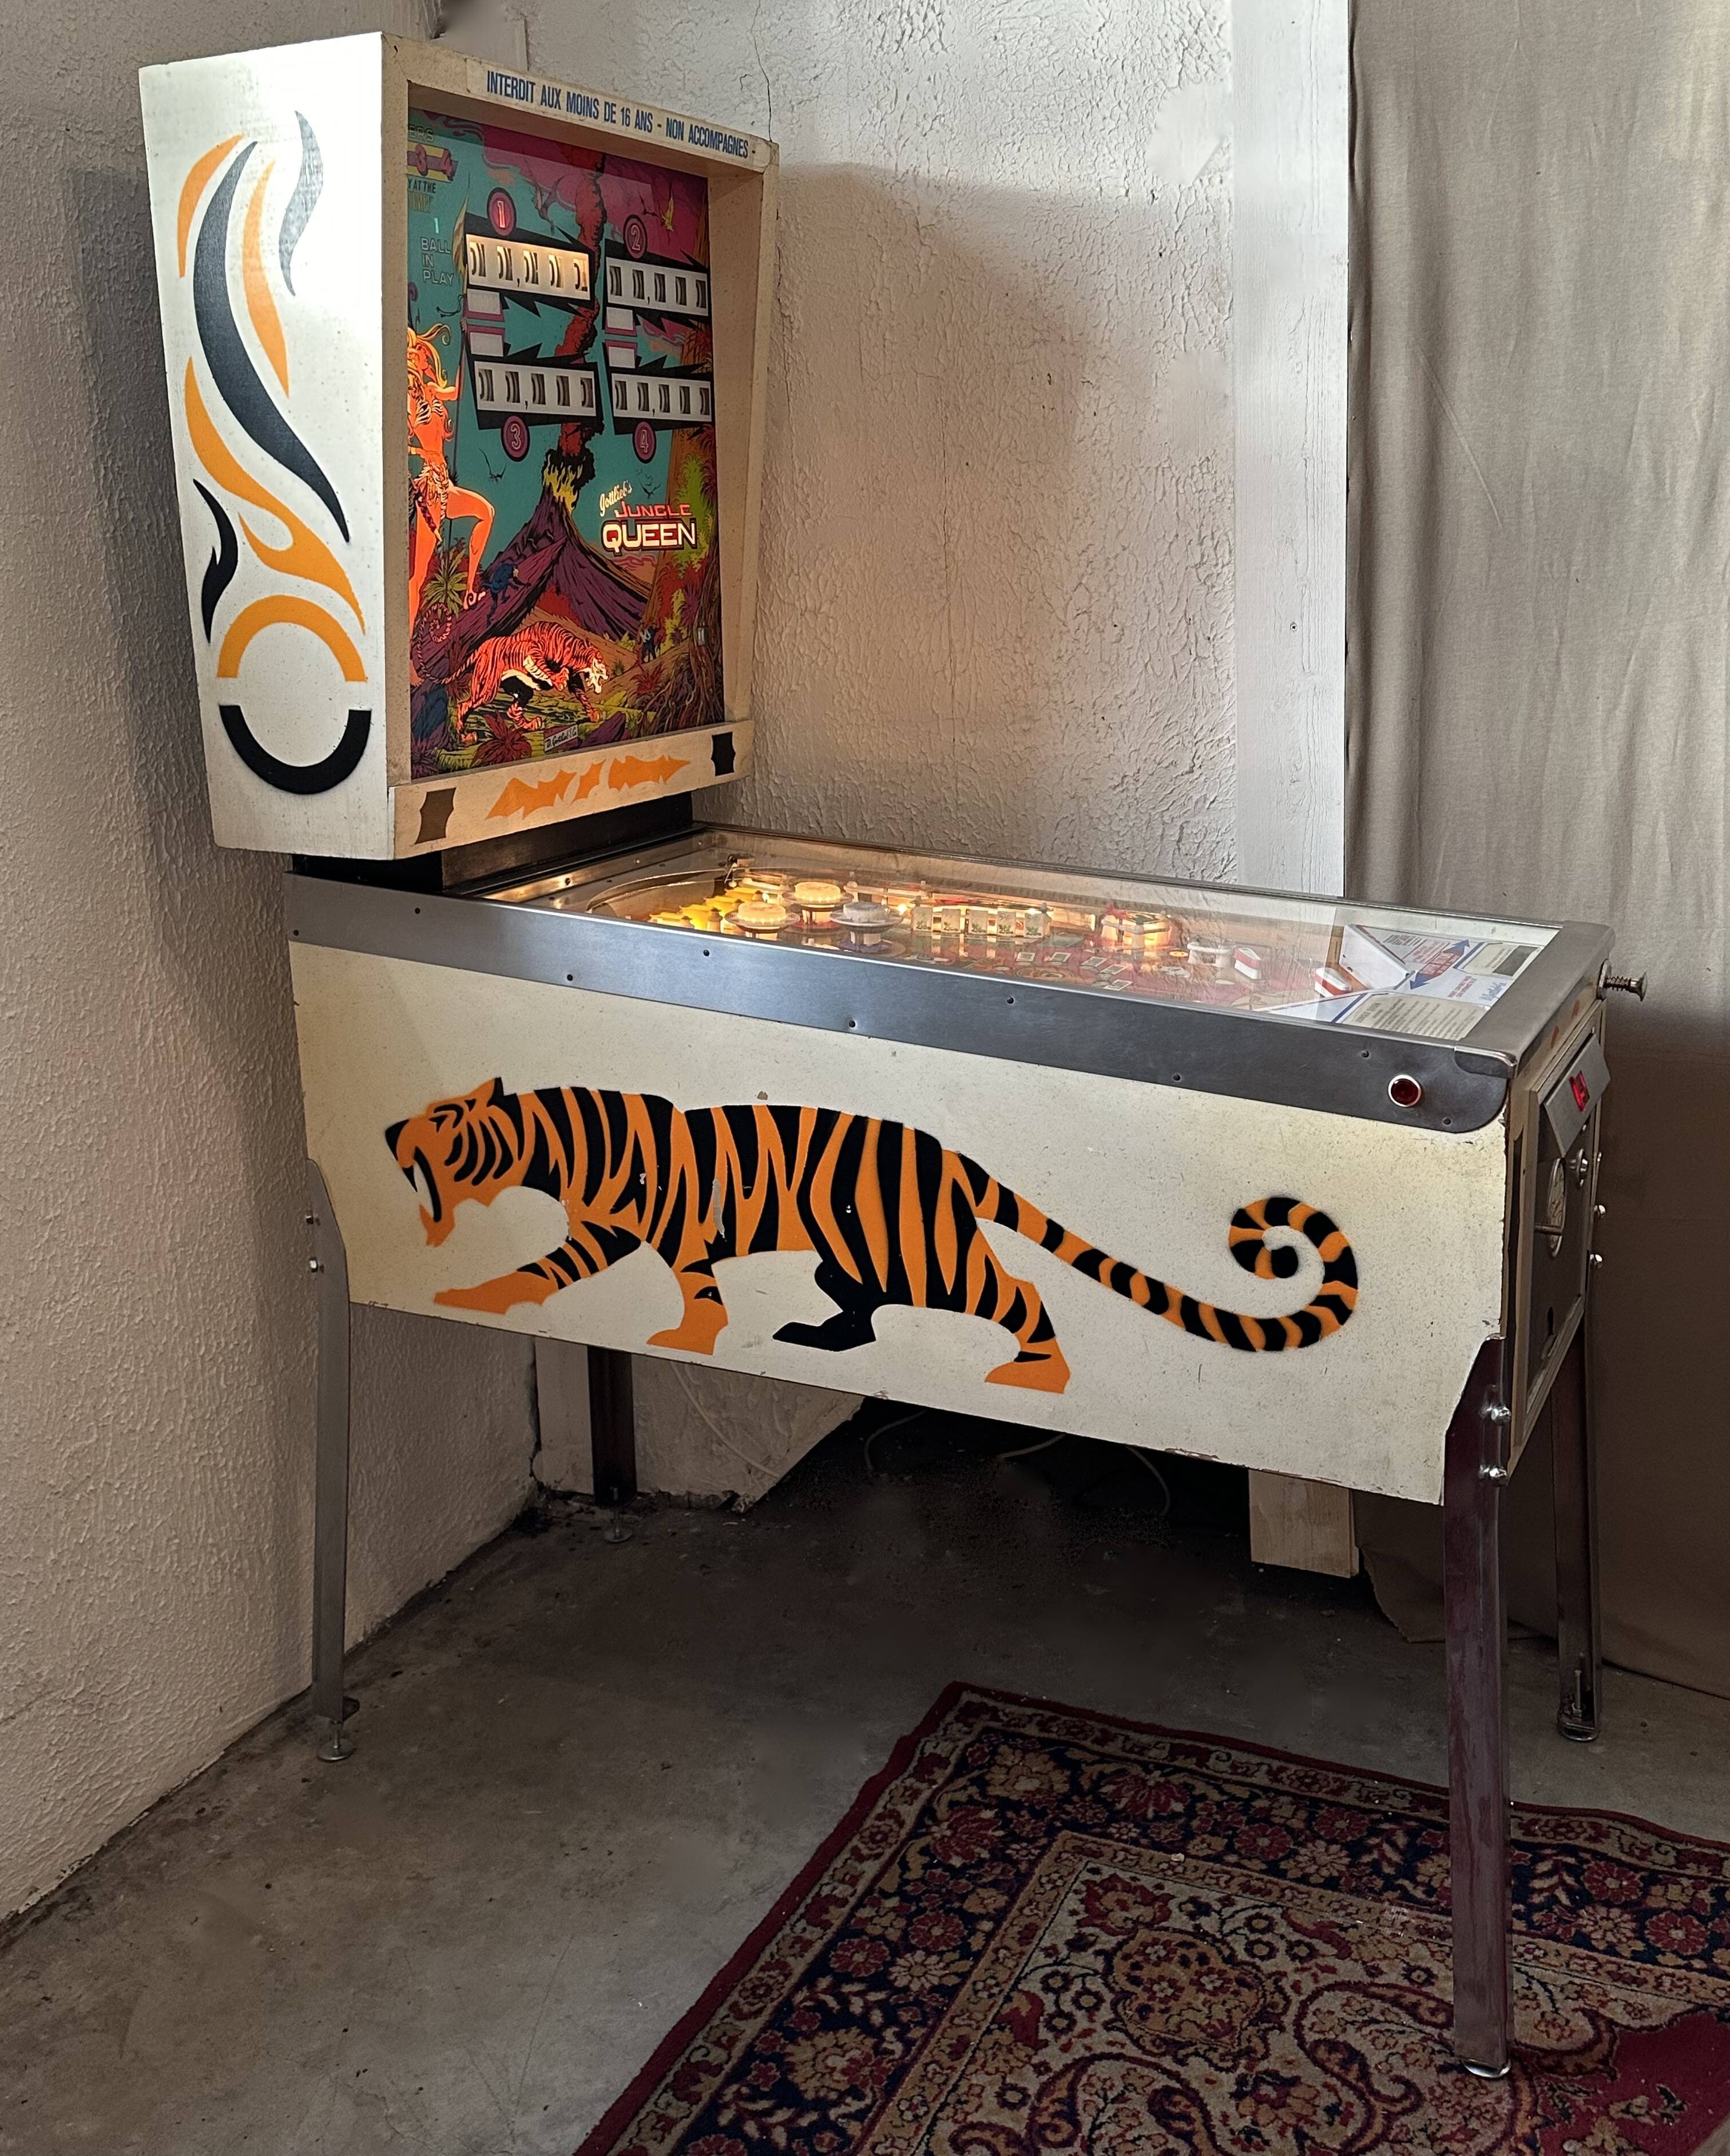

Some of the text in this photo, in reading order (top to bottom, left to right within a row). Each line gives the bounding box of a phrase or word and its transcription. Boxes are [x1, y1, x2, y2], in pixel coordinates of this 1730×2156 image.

[487, 70, 536, 104] INTERDIT
[540, 84, 562, 110] AUX
[566, 91, 600, 120] MOINS
[604, 101, 617, 124] DE
[621, 106, 631, 127] 16
[634, 109, 653, 133] ANS
[666, 117, 685, 141] NON
[688, 124, 749, 159] ACCOMPAGNES
[413, 179, 422, 191] AT
[423, 181, 437, 193] THE
[497, 200, 507, 228] 1
[420, 236, 451, 254] BALL
[630, 225, 641, 251] 2
[422, 254, 434, 268] IN
[423, 270, 455, 286] PLAY
[510, 423, 521, 450] 3
[640, 429, 649, 453] 4
[614, 501, 692, 518] JUNGLE
[602, 521, 696, 554] QUEEN
